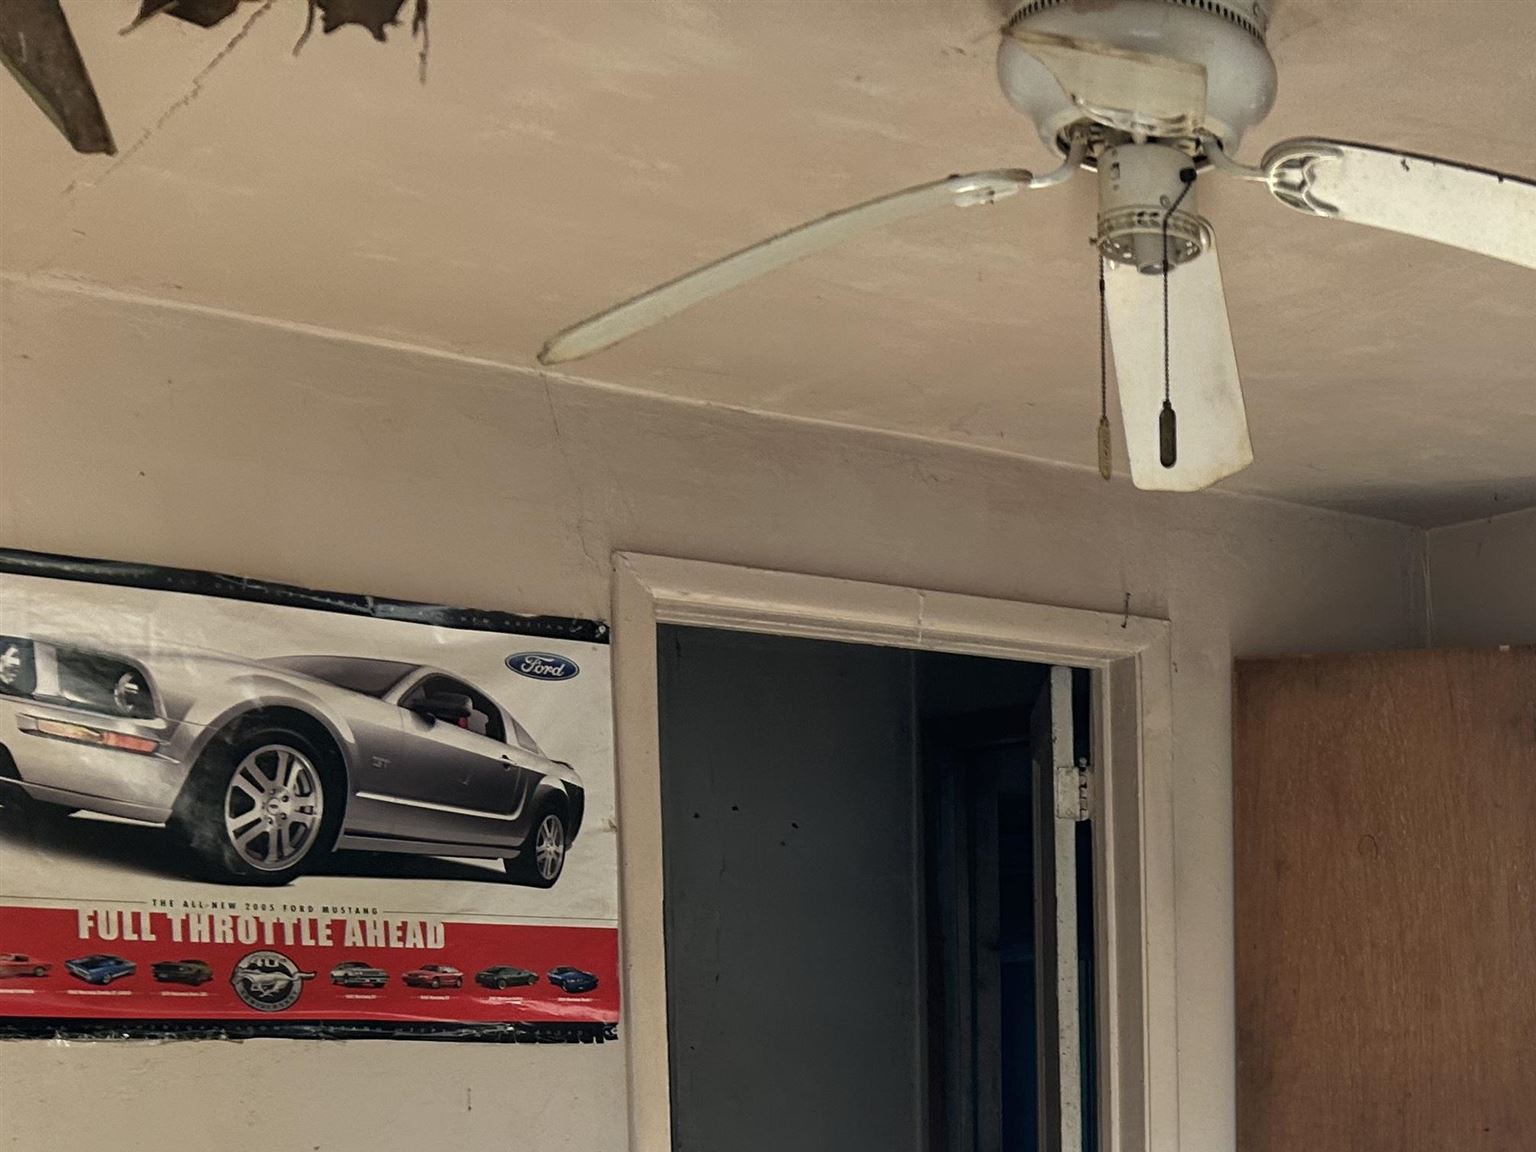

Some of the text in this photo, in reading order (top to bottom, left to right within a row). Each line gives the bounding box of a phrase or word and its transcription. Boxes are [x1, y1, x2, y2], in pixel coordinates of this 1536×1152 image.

[520, 655, 566, 677] Ford
[152, 899, 379, 915] THE ALL-NEW 2005 FORD MUSTANG
[77, 906, 446, 949] FULL THROTTLE AHEAD
